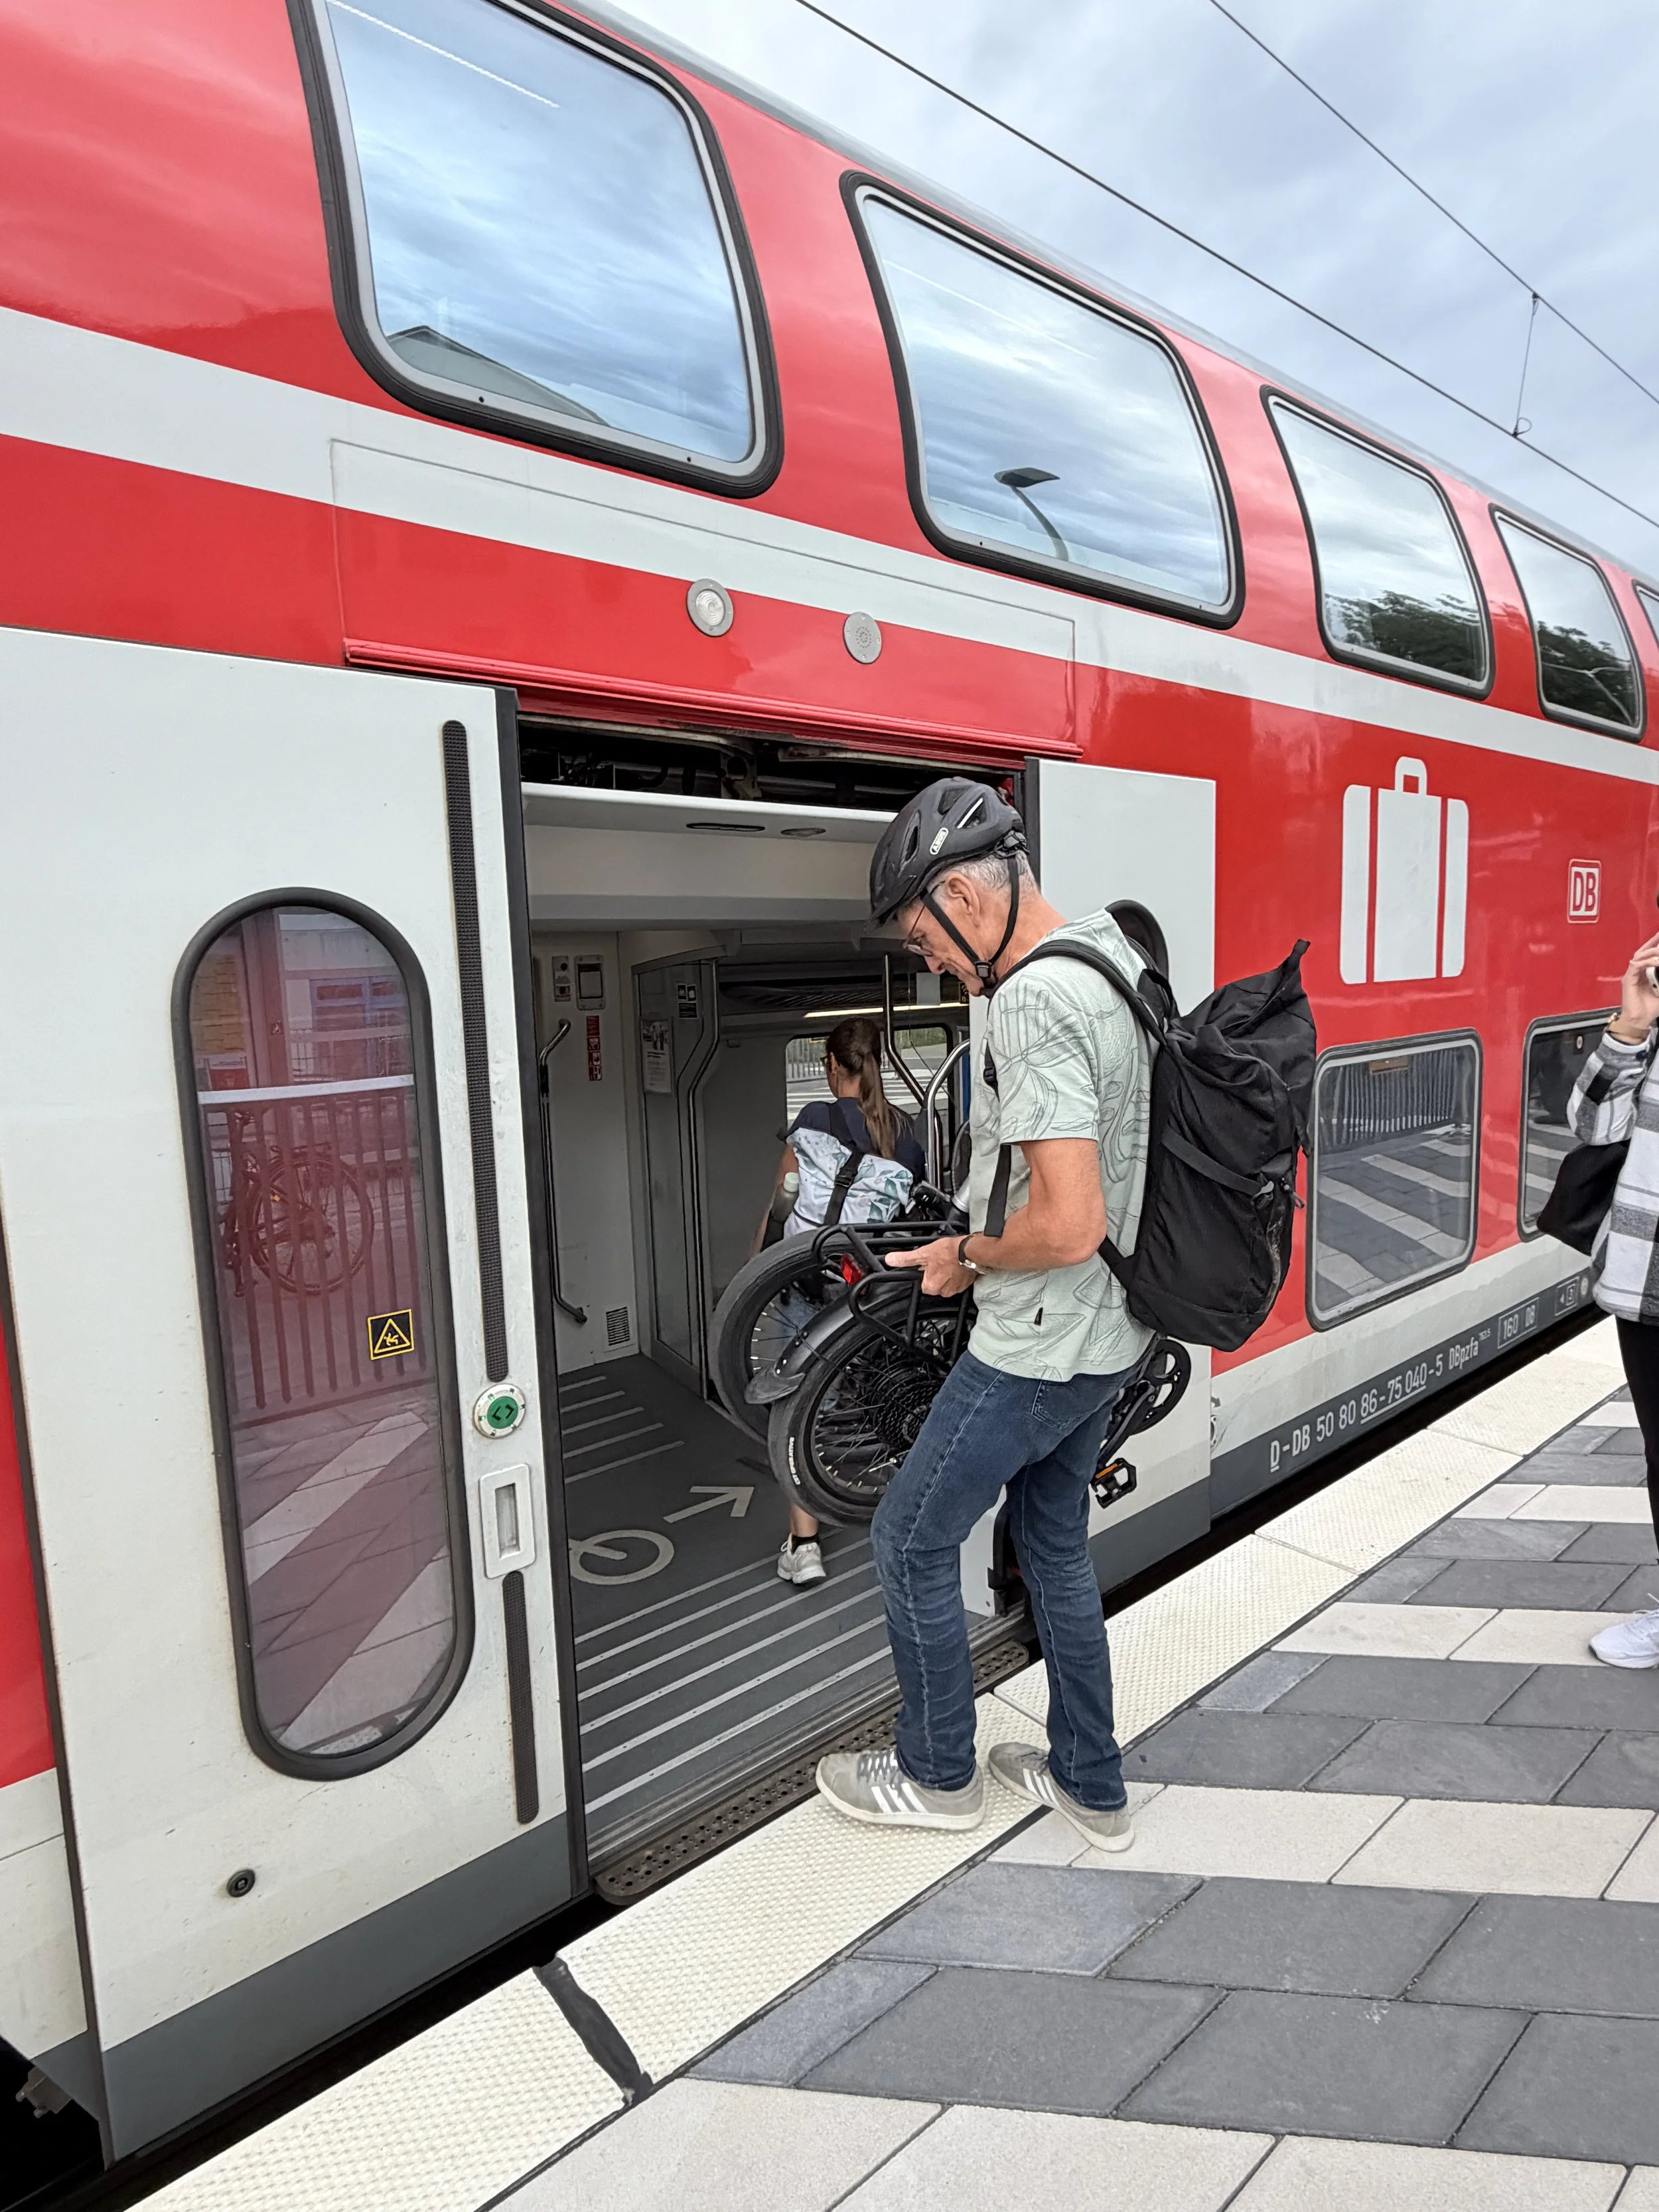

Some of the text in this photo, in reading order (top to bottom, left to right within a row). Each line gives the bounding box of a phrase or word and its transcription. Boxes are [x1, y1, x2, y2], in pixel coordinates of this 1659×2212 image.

[1572, 871, 1596, 912] DB
[1502, 1313, 1519, 1340] 160
[1317, 1412, 1334, 1442] 50
[1339, 1400, 1356, 1430] 80
[1449, 1337, 1479, 1370] DBpzfa
